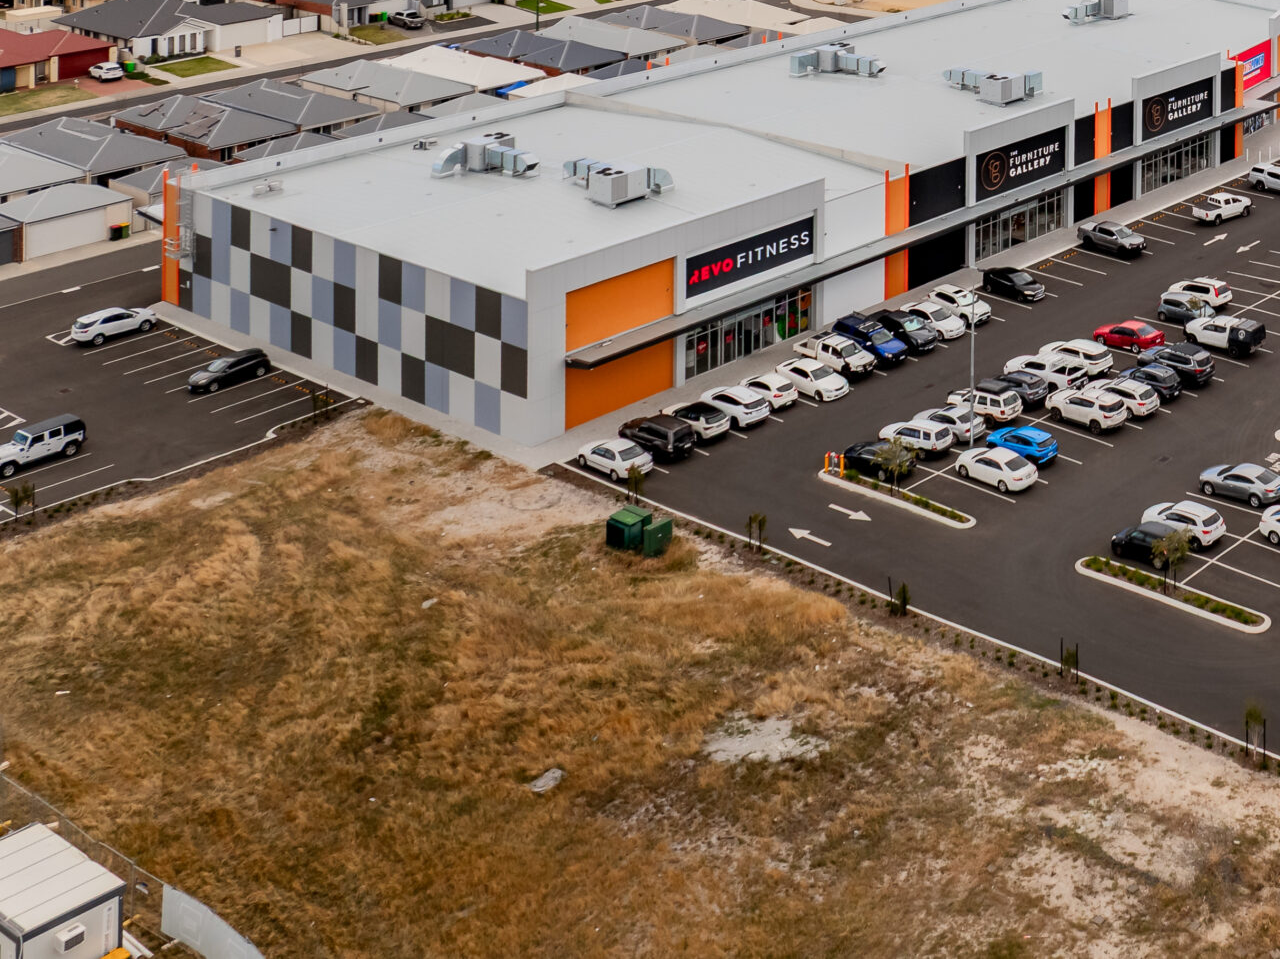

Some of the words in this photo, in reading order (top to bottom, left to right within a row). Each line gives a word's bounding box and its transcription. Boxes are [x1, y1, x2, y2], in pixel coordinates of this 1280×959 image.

[1168, 91, 1209, 112] FURNITURE
[1168, 103, 1202, 121] GALLERY
[1009, 142, 1060, 167] FURNITURE
[1009, 155, 1051, 177] GALLERY
[689, 258, 734, 285] REVO
[737, 231, 810, 268] FITNESS
